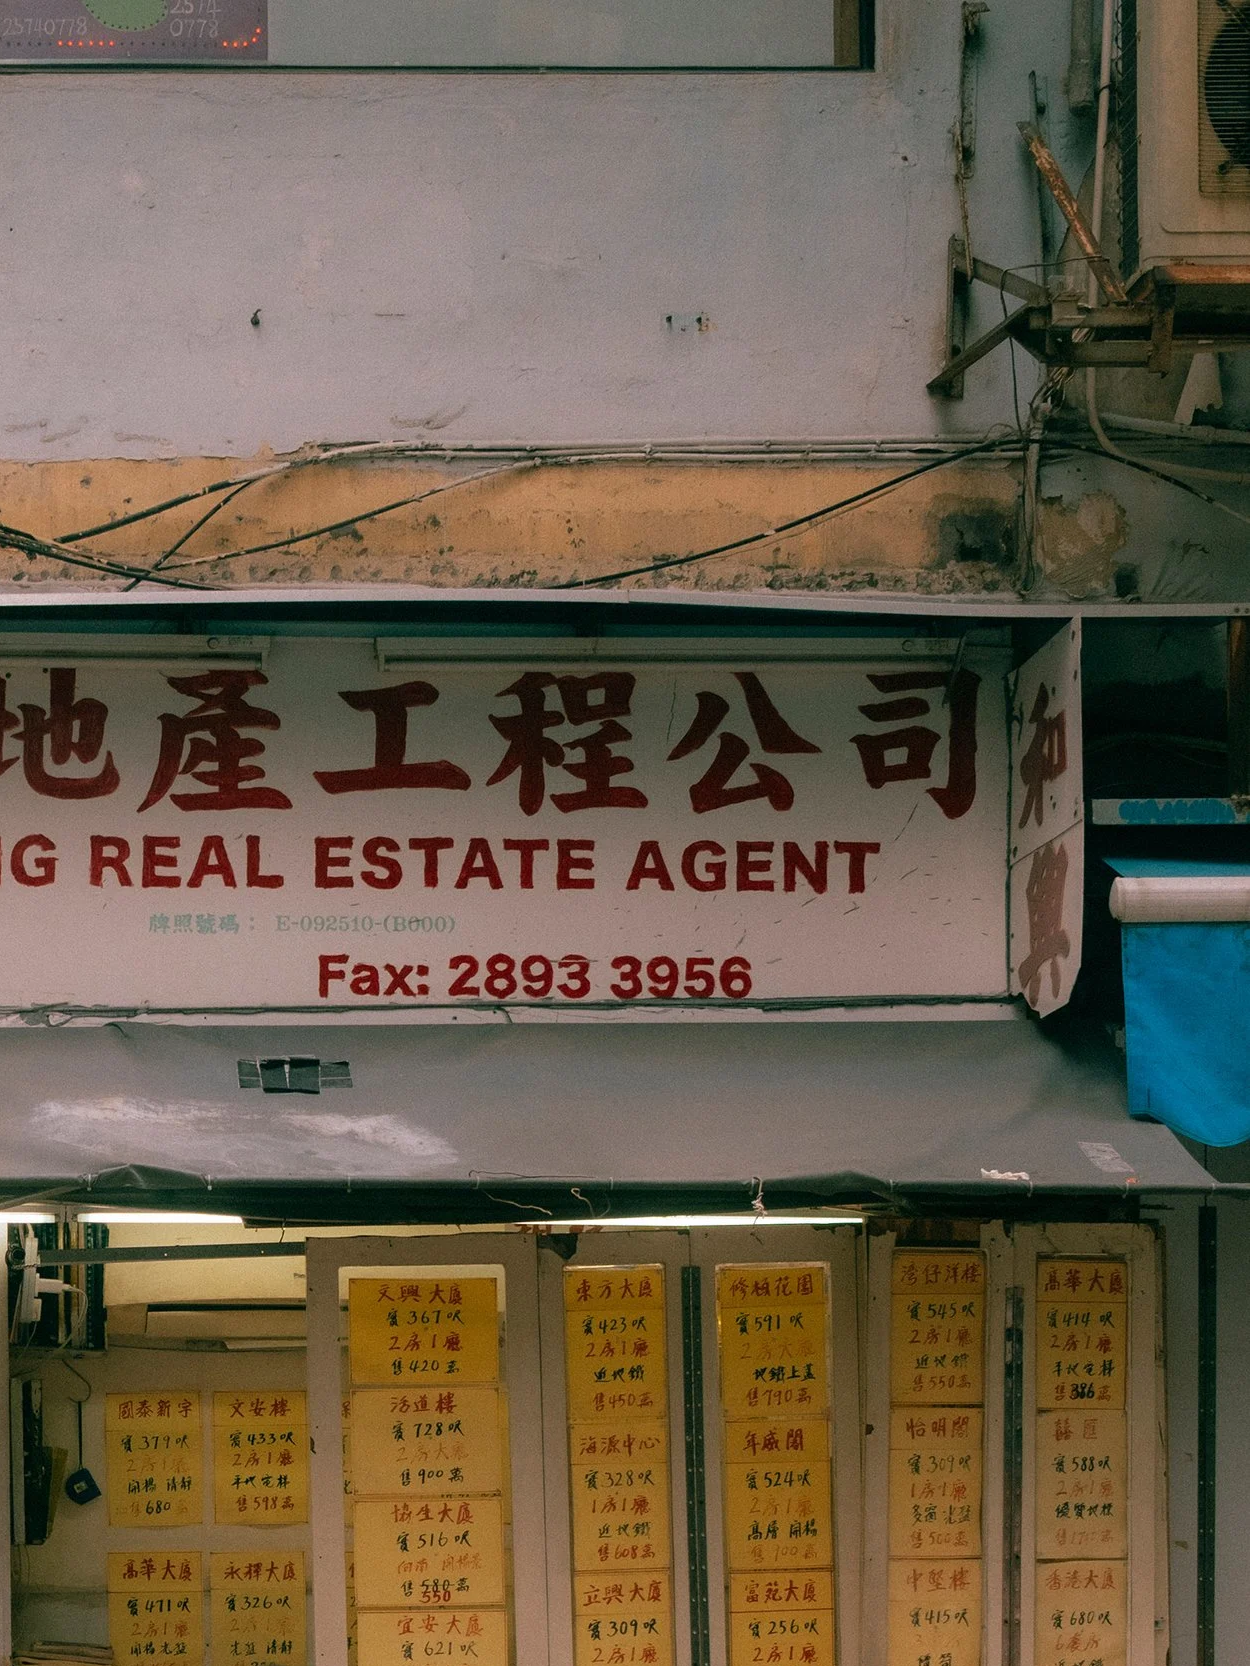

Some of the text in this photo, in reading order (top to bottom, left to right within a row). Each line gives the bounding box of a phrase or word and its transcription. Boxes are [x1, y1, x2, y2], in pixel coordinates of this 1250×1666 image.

[89, 834, 284, 889] REAL
[314, 836, 595, 891] ESTATE
[626, 840, 881, 894] AGENT
[1019, 681, 1071, 1008] 和興
[319, 953, 752, 1000] Fax: 2893 3956
